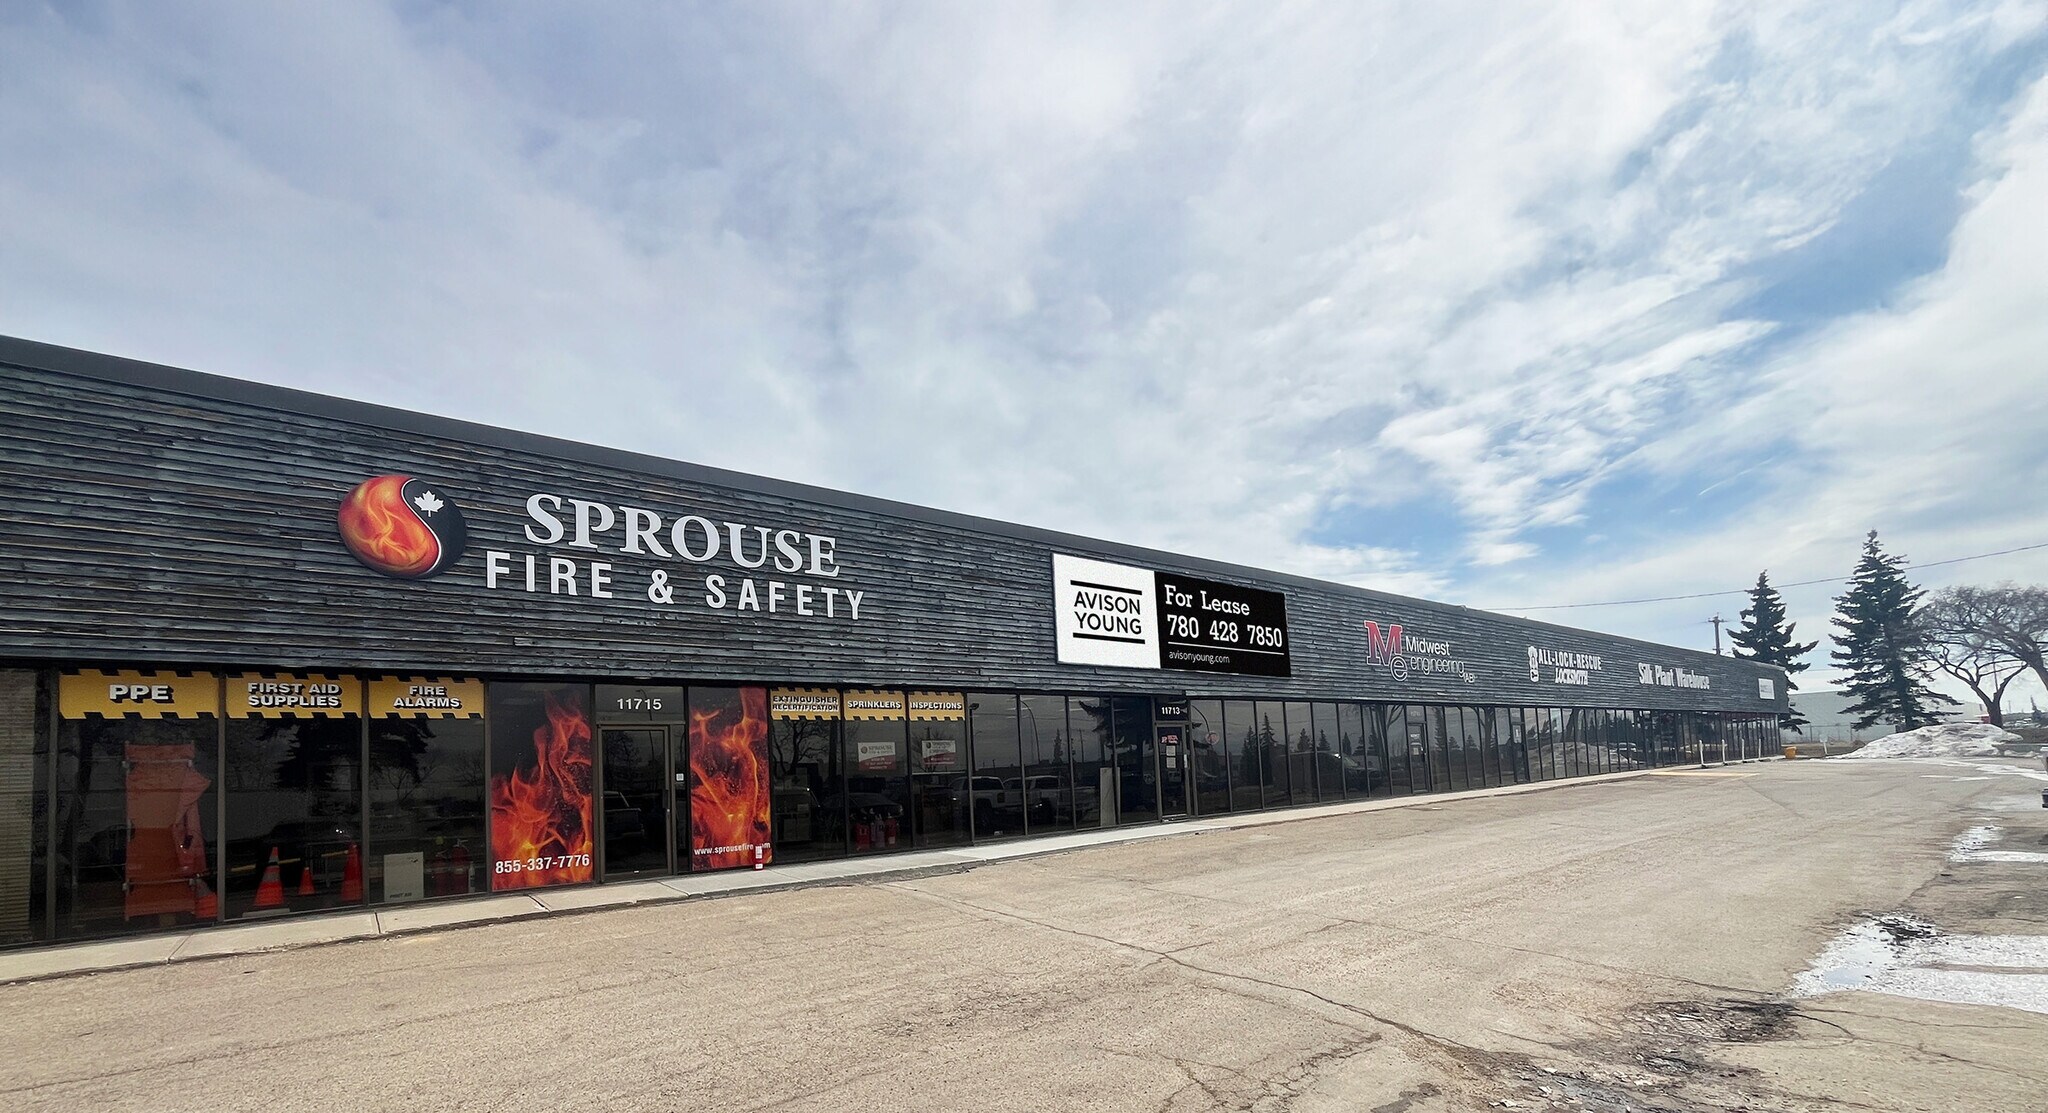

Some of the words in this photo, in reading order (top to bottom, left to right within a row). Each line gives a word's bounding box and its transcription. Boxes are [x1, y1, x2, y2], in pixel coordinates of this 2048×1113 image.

[524, 493, 840, 578] SPROUSE
[486, 550, 613, 599] FIRE
[647, 569, 675, 604] &
[704, 574, 864, 620] SAFETY
[1074, 590, 1141, 615] AVISON
[1164, 584, 1193, 608] For
[1200, 590, 1250, 616] Lease
[1074, 611, 1142, 635] YOUNG
[1167, 614, 1199, 638] 780
[1209, 620, 1239, 643] 428
[1247, 624, 1283, 648] 7850
[1405, 635, 1450, 656] Midwest
[1169, 651, 1230, 664] avisonyoung.com
[1410, 656, 1465, 678] engineering
[109, 684, 174, 703] PPE
[248, 682, 303, 694] FIRST
[309, 683, 341, 695] AID
[409, 685, 446, 696] FIRE
[248, 694, 341, 708] SUPPLIES
[393, 697, 461, 709] ALARMS
[617, 698, 662, 710] 11715
[772, 695, 838, 704] EXTINGUISHER
[847, 700, 902, 710] SPRINKLERS
[910, 701, 963, 711] INSPECTIONS
[772, 704, 838, 713] RECERTIFICATION
[1161, 706, 1181, 715] 11713
[495, 853, 590, 874] 855-337-7776
